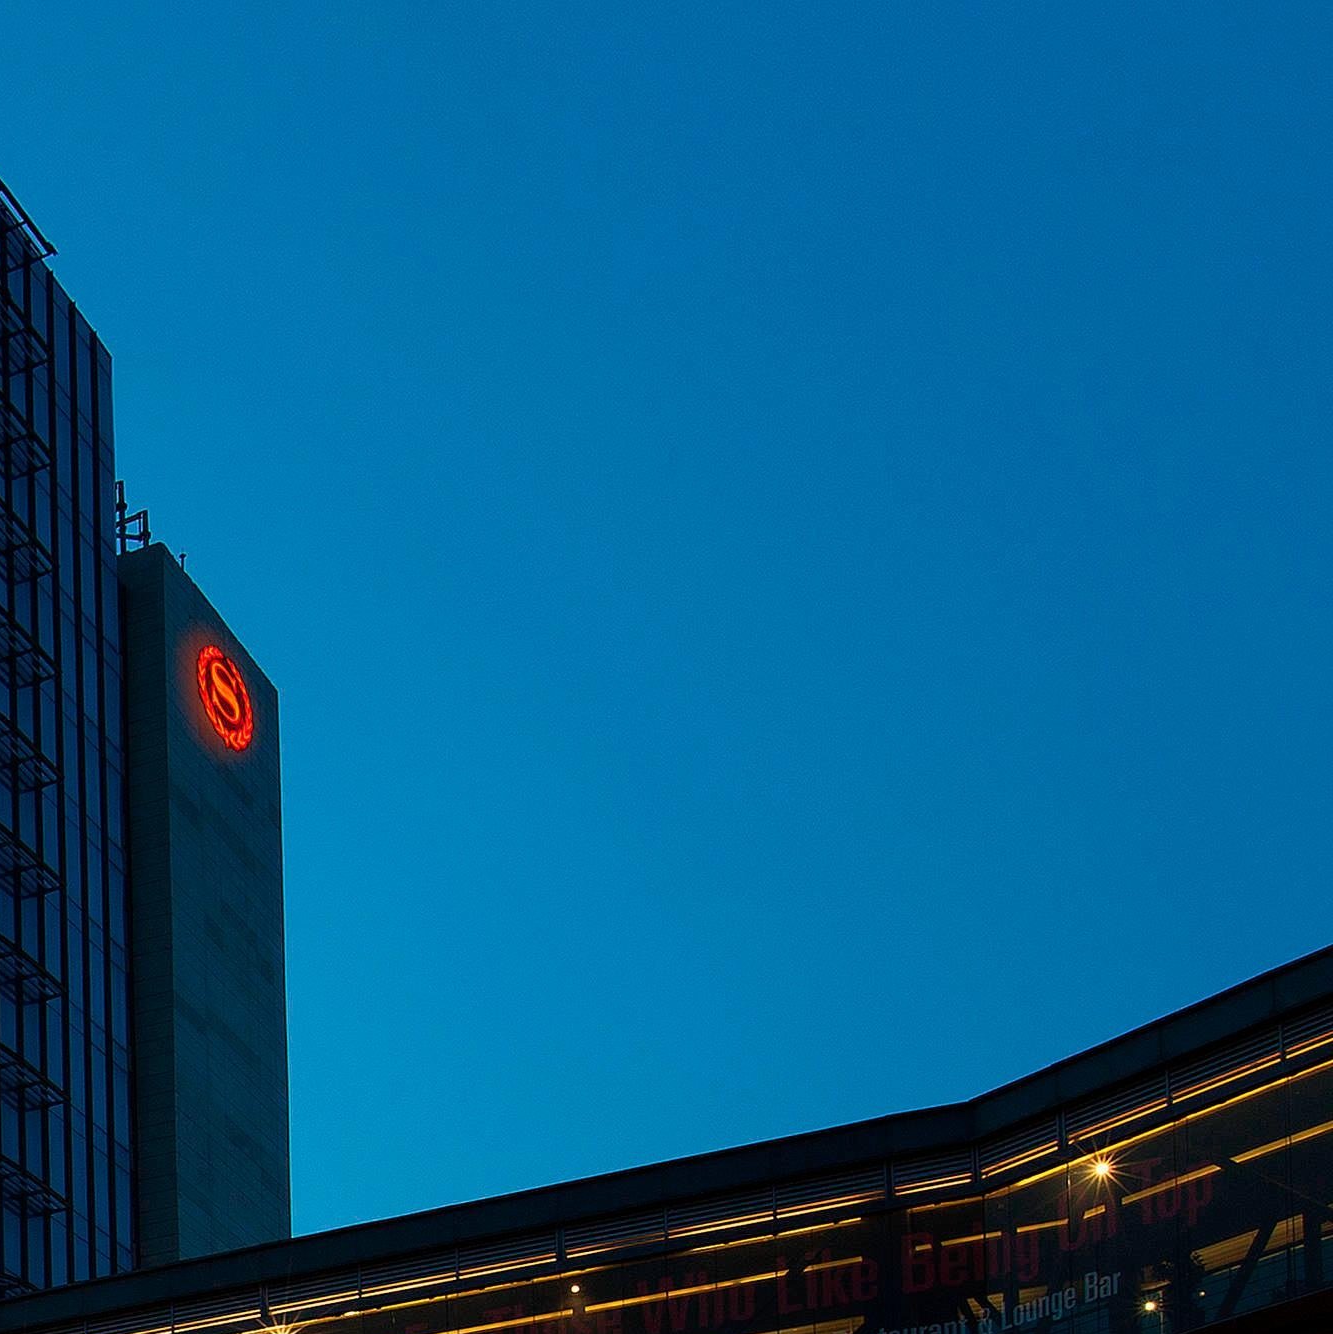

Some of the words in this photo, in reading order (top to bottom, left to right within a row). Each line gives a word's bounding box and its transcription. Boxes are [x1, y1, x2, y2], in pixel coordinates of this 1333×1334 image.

[775, 1246, 879, 1315] Like
[900, 1216, 1040, 1295] Being
[1130, 1156, 1214, 1227] Top
[1000, 1286, 1077, 1331] Lounge
[1084, 1271, 1121, 1303] Bar
